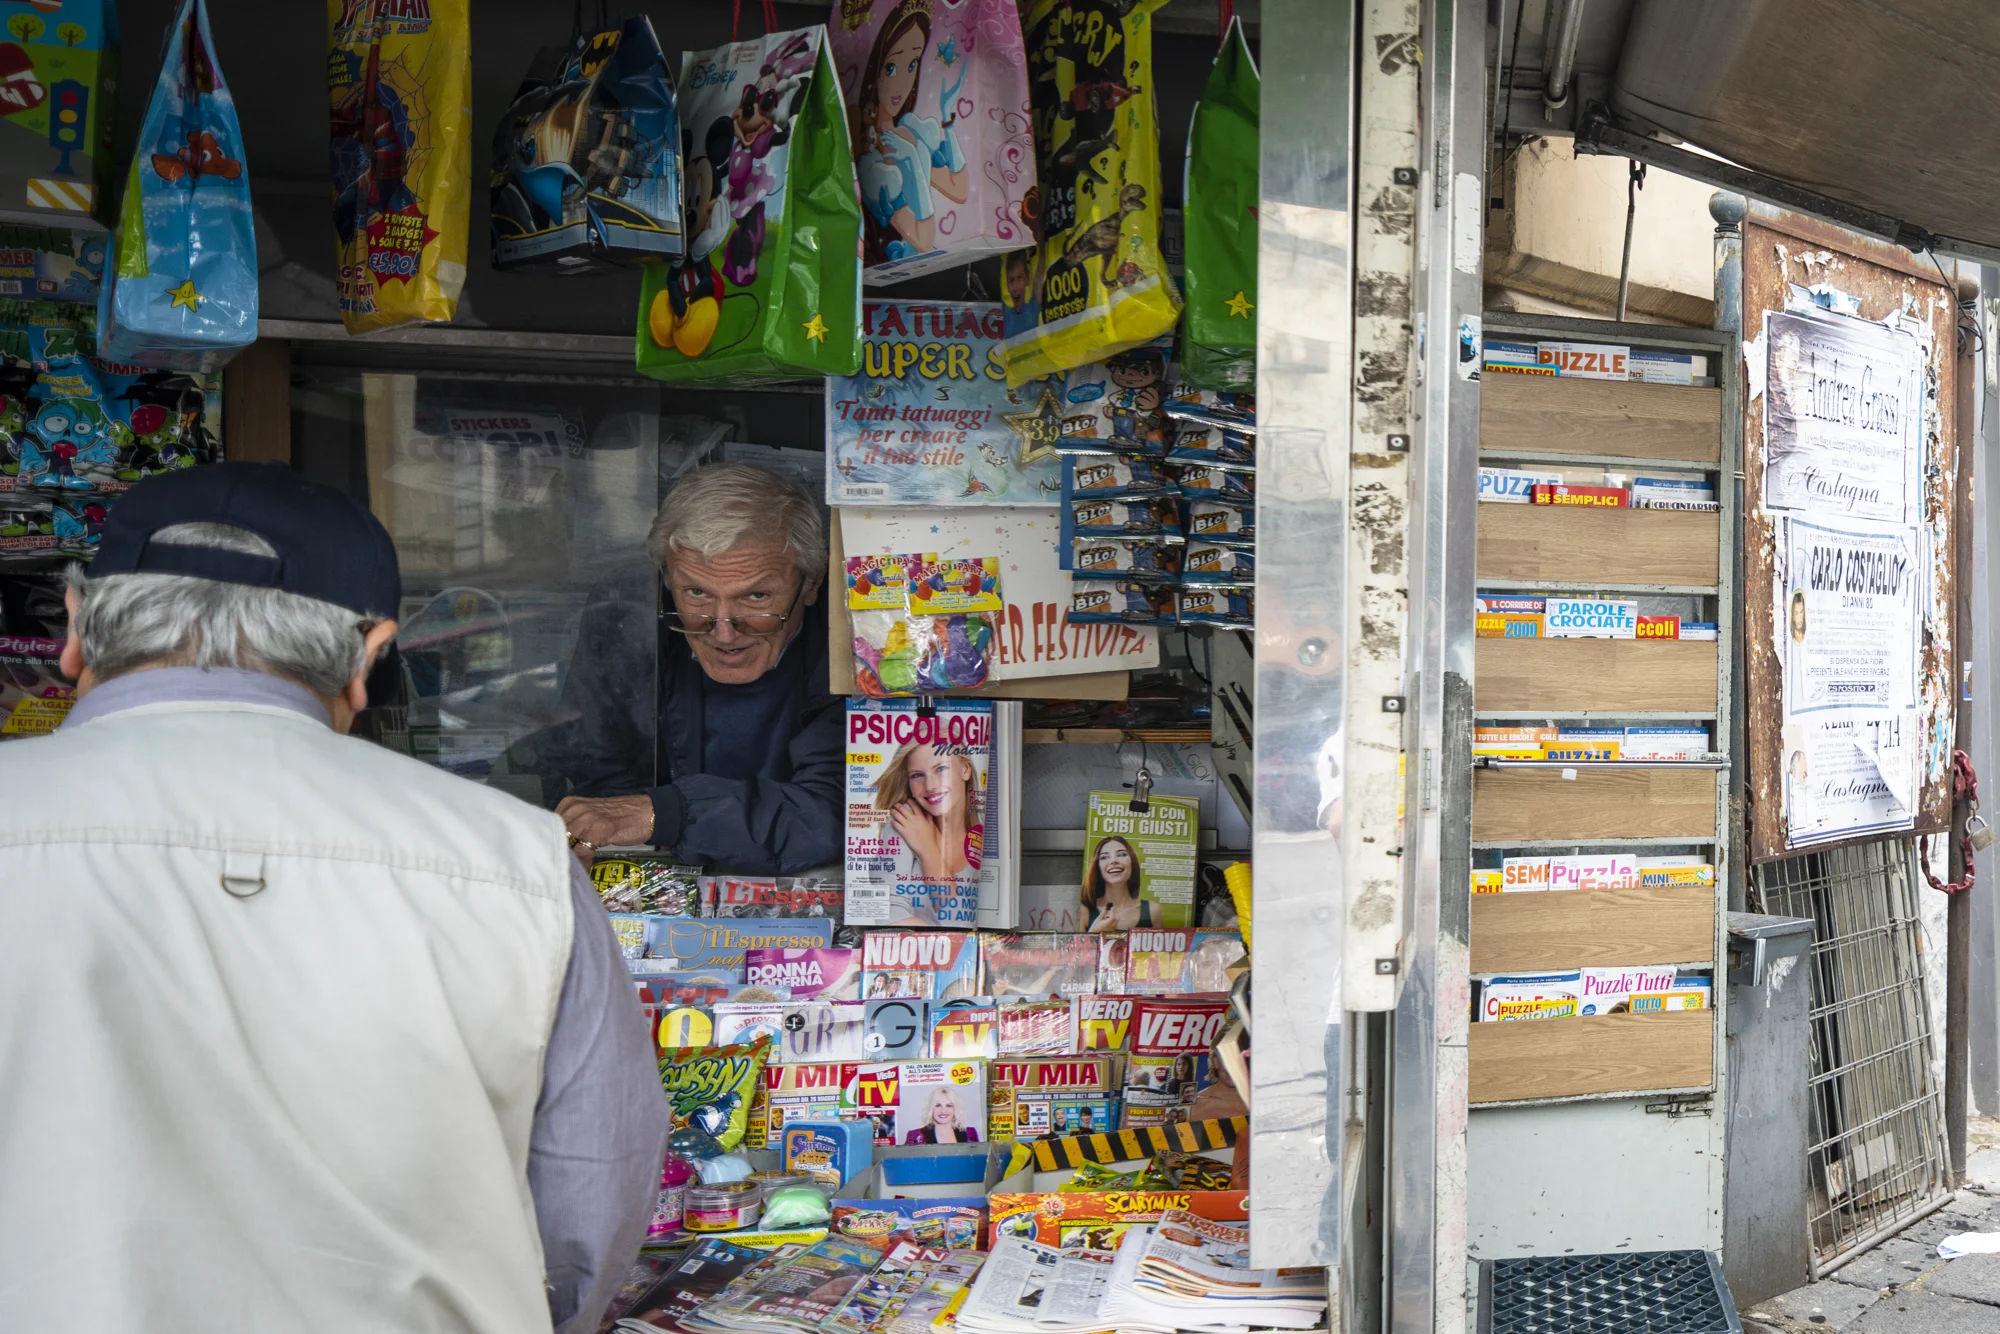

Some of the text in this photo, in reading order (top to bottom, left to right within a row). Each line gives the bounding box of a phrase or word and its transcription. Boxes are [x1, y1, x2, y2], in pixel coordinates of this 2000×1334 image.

[391, 214, 423, 227] RIVISTE
[391, 226, 424, 240] GADGET
[369, 251, 419, 277] €5,90!
[1046, 267, 1082, 304] 1000
[863, 304, 1005, 340] TATUAG
[851, 341, 977, 380] UPER
[1538, 350, 1627, 374] PUZZLE
[1805, 351, 1902, 436] Andrea Grassi
[836, 399, 993, 431] Tanti tatuaggi
[451, 418, 531, 432] STICKERS
[1022, 419, 1060, 443] €3,9
[856, 429, 968, 450] per creare
[864, 444, 965, 466] il tuo stile
[1478, 475, 1559, 497] PUZZ
[1804, 465, 1881, 512] Castagna
[1553, 494, 1619, 506] SEMPLICI
[1653, 500, 1719, 512] CRUCINTARSIO
[851, 557, 888, 581] MAGIC
[912, 562, 992, 585] MAGIC PARTY
[1811, 545, 1900, 597] CARLO COSTAGLIO
[1491, 600, 1533, 609] IL CORRIERE
[1558, 602, 1627, 616] PAROLE
[1842, 595, 1849, 608] DI
[1850, 596, 1864, 608] ANNI
[1476, 619, 1506, 629] UZZLE
[1504, 621, 1538, 638] 2000
[1549, 614, 1634, 629] CROCIATE
[1636, 620, 1674, 637] ccoli
[996, 603, 1026, 665] ER
[27, 655, 43, 664] alla
[17, 718, 46, 727] KIT DI
[1478, 733, 1499, 741] TUTTE
[1500, 733, 1508, 741] LE
[850, 754, 879, 763] Test:
[850, 772, 870, 780] gestisci
[1159, 806, 1186, 820] CON
[1092, 819, 1189, 837] I CIBI GIUSTI
[848, 836, 900, 846] L'arte di
[847, 847, 901, 856] educare:
[1552, 860, 1632, 884] Puzzle
[1642, 873, 1669, 884] MINI
[895, 884, 952, 896] SCOPRI
[912, 897, 958, 909] IL TUO
[938, 910, 952, 921] DI
[710, 925, 825, 950] l'Espresso
[1131, 932, 1186, 953] NUOVO
[866, 935, 951, 966] NUOVO
[748, 960, 823, 981] DONNA
[1131, 951, 1186, 980] TV
[1583, 972, 1673, 995] Puzzle Tutti
[1080, 1001, 1133, 1019] VERO
[1501, 1004, 1542, 1015] PUZZLE
[1633, 997, 1661, 1009] TUTTO
[1080, 1019, 1131, 1049] TV
[1138, 1011, 1225, 1047] VERO
[795, 1064, 838, 1090] MI
[951, 1066, 974, 1078] 0,50
[996, 1063, 1099, 1087] TV MIA
[859, 1080, 899, 1104] TV
[913, 1205, 980, 1219] MAGAZINE GIOCO
[1046, 1200, 1060, 1211] 16
[1104, 1193, 1192, 1214] SCARYMALS
[1169, 1209, 1247, 1239] ENIGMIST
